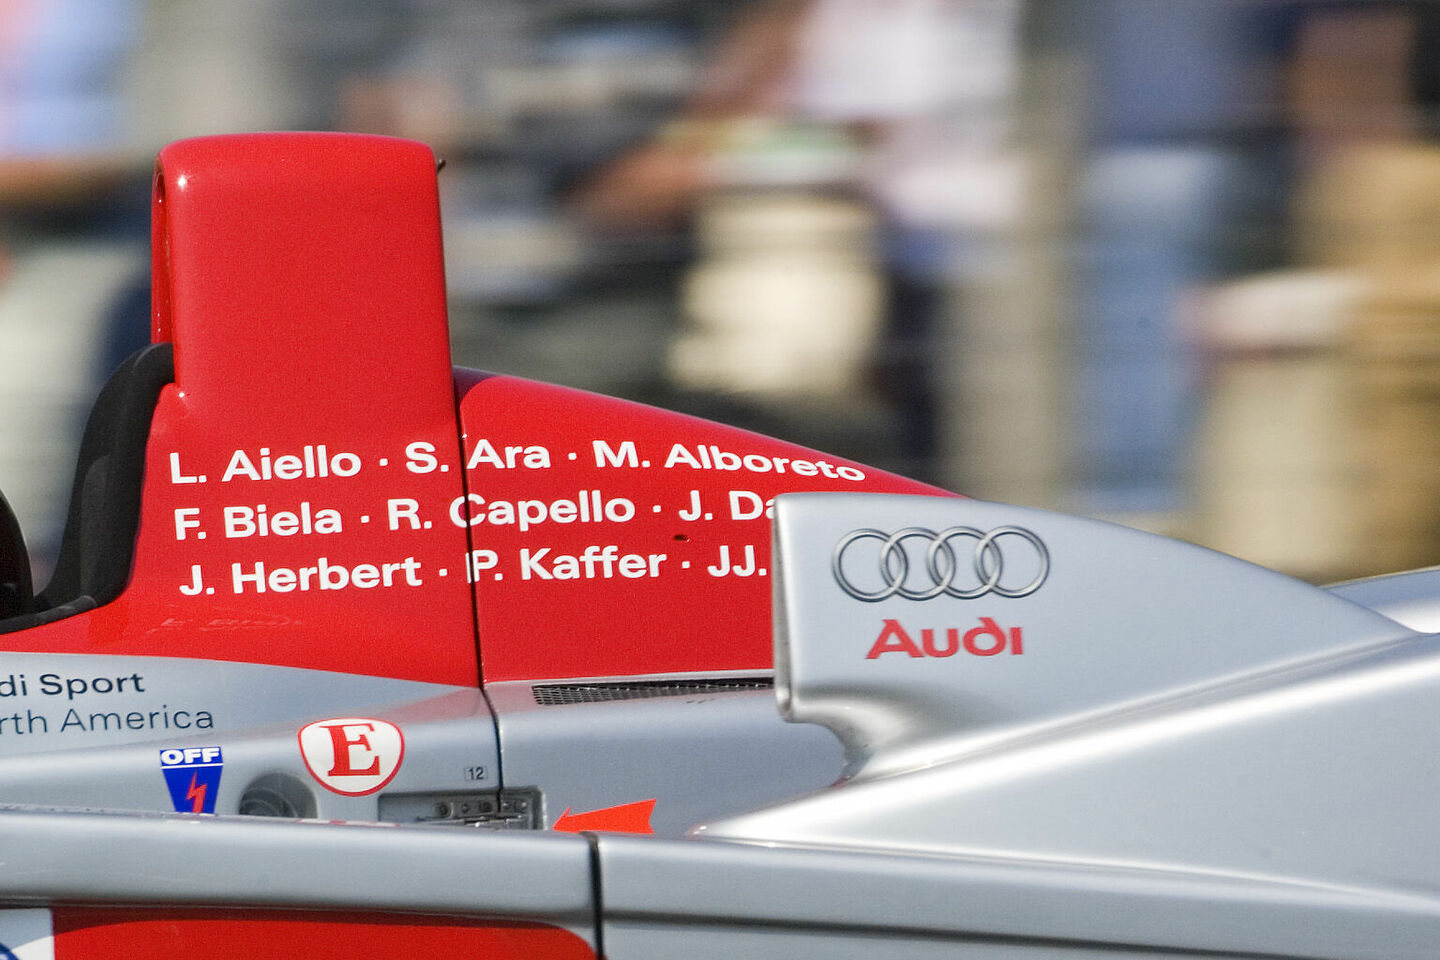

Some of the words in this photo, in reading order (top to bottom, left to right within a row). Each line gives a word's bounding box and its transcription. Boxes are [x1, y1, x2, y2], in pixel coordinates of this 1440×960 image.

[169, 452, 208, 484] L.
[221, 444, 362, 482] Aiello
[405, 441, 450, 474] S.
[466, 438, 551, 470] Ara
[592, 439, 651, 468] M.
[663, 443, 866, 481] Alboreto
[174, 507, 208, 540] F.
[223, 500, 343, 539] Biela
[387, 498, 433, 531] R.
[448, 489, 636, 532] Capello
[678, 489, 713, 522] J.
[179, 564, 216, 596] J.
[231, 555, 424, 594] Herbert
[464, 549, 504, 584] P.
[519, 545, 667, 581] Kaffer
[707, 544, 767, 578] JJ.
[866, 616, 1024, 660] Audi
[39, 672, 147, 701] Sport
[60, 706, 214, 733] America
[161, 747, 222, 765] OFF
[321, 722, 380, 777] E
[467, 766, 485, 781] 12
